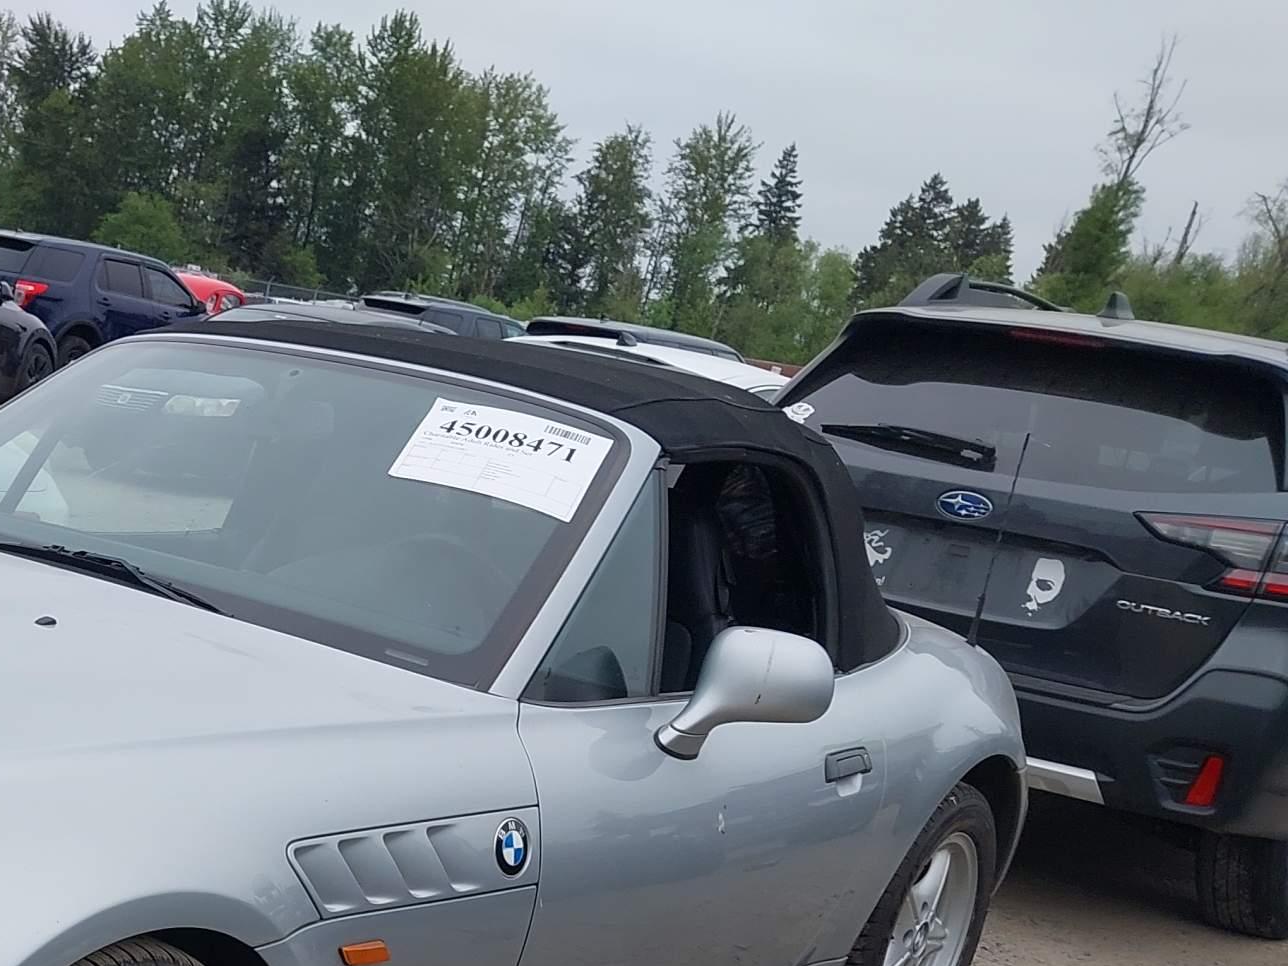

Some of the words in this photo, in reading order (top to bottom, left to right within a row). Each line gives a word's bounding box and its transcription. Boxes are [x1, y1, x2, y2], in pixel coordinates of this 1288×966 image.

[439, 419, 577, 463] 45008471
[1116, 600, 1211, 625] OUTBACK
[498, 822, 525, 839] BMW
